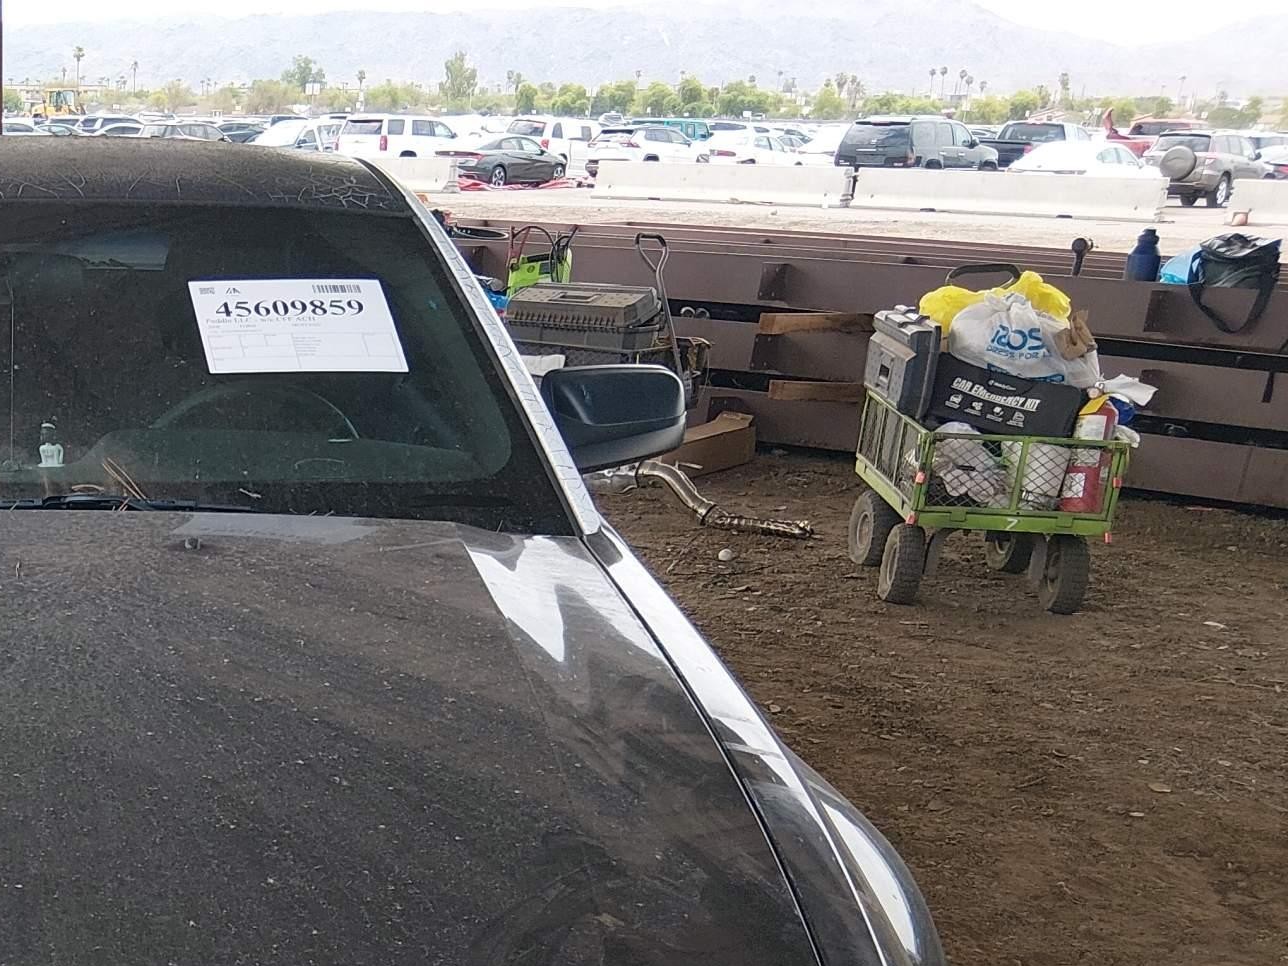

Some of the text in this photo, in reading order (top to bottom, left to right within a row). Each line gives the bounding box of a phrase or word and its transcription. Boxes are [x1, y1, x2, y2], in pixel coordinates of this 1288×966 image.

[215, 299, 364, 317] 45609859
[952, 377, 974, 393] CAR
[971, 384, 1026, 408] EMERGENCY
[1024, 398, 1042, 411] KIT
